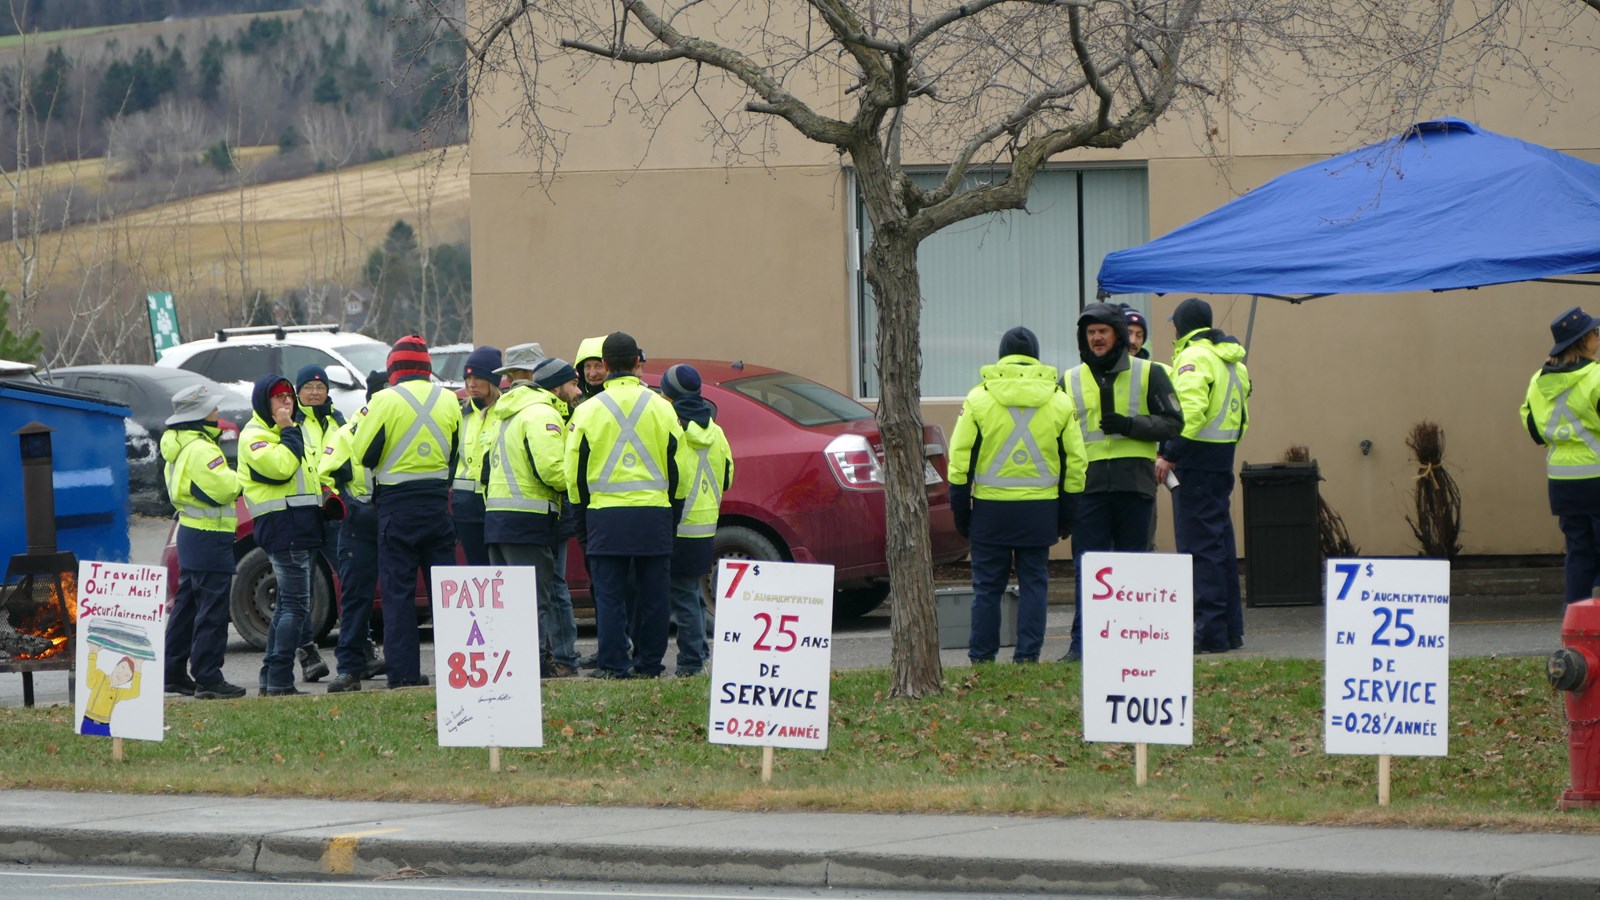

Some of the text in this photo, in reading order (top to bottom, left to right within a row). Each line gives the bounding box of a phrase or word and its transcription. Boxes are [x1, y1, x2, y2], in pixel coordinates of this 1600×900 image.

[91, 563, 162, 581] Travailler
[1092, 566, 1177, 603] Sécurité
[440, 569, 504, 609] PAYÉ
[1361, 590, 1449, 605] D'AUGMENTATION
[80, 597, 164, 623] Sécuritairement!
[466, 610, 486, 646] À
[723, 612, 829, 653] EN 25 ANS
[1336, 606, 1445, 649] EN 25 ANS
[447, 649, 513, 690] 85%
[759, 663, 780, 678] DE
[1121, 668, 1157, 683] pour
[1373, 657, 1396, 673] DE
[720, 682, 818, 710] SERVICE
[1342, 677, 1437, 706] SERVICE
